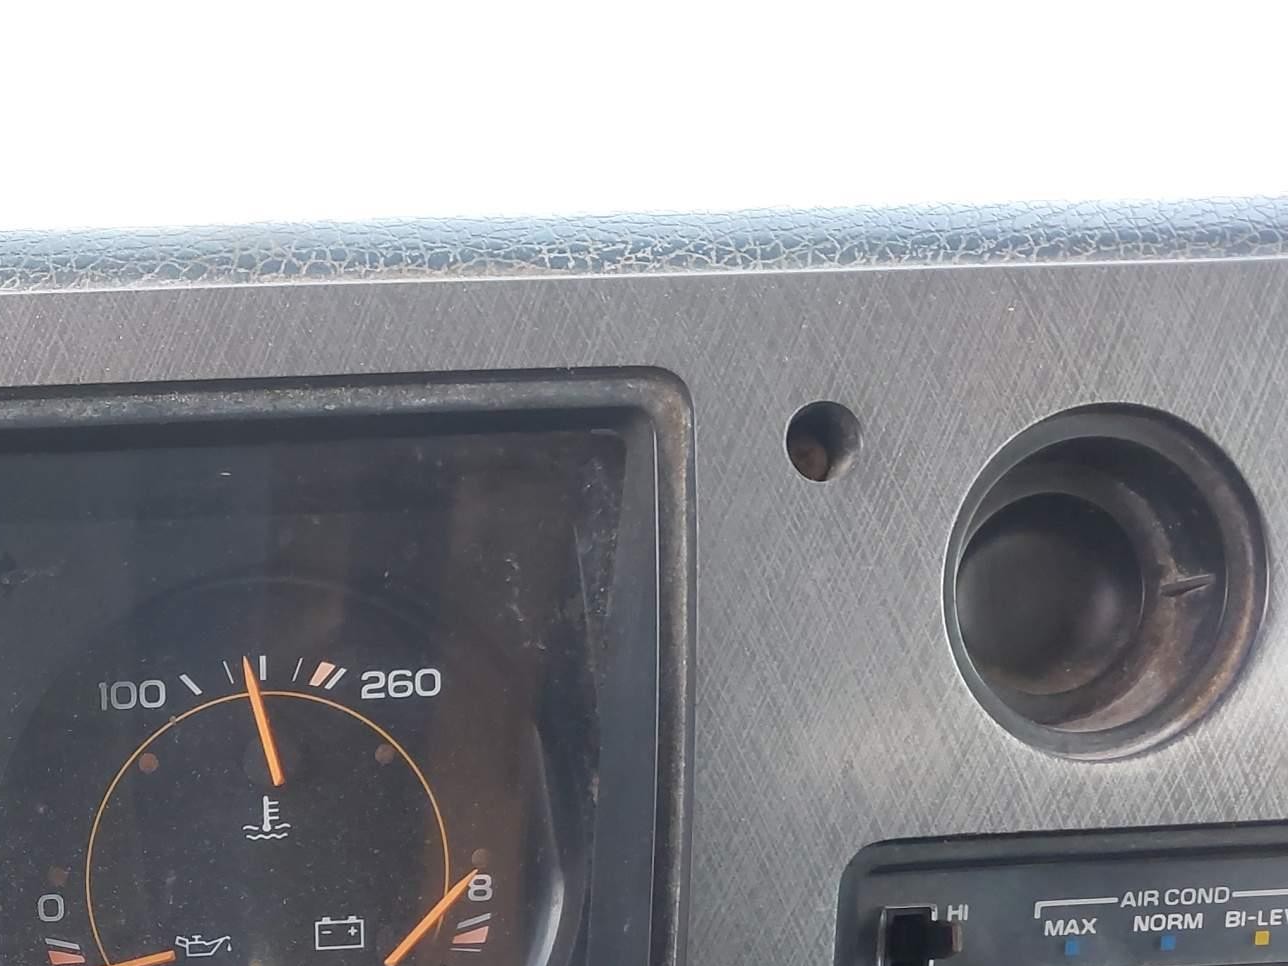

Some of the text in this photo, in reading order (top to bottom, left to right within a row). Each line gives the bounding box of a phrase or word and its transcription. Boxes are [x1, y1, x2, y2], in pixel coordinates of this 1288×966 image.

[99, 680, 166, 710] 100
[360, 668, 442, 699] 260
[467, 875, 493, 901] 8
[1120, 886, 1230, 908] AIR COND
[37, 894, 65, 923] 0
[947, 904, 968, 921] HI
[1044, 918, 1098, 936] MAX
[1133, 913, 1203, 932] NORM
